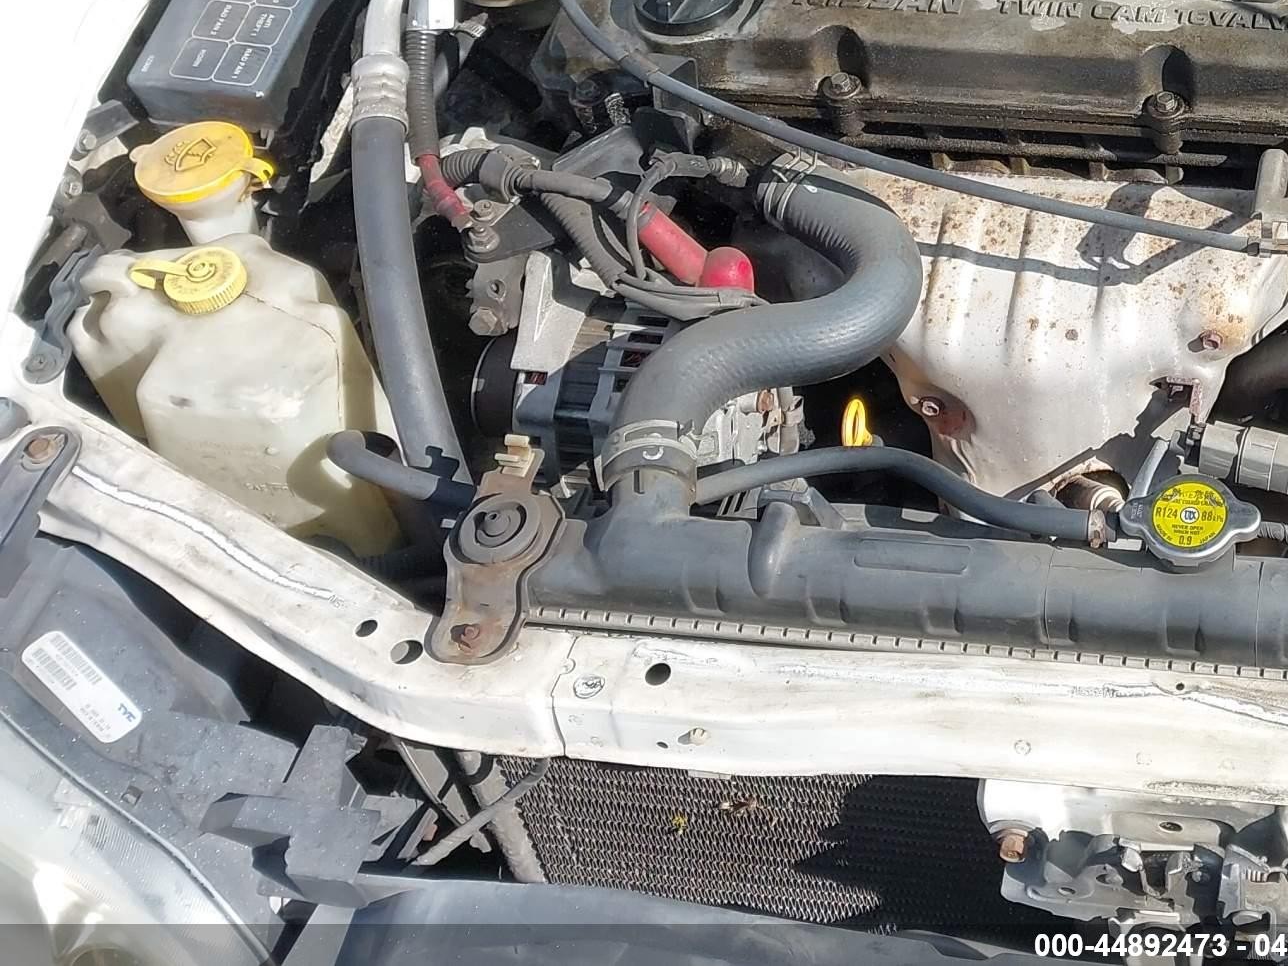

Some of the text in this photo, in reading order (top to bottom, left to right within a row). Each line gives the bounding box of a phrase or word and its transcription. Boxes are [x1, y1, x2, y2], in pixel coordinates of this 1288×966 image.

[1091, 3, 1169, 24] CAM
[1155, 506, 1178, 519] R124
[1179, 535, 1193, 546] 0.9
